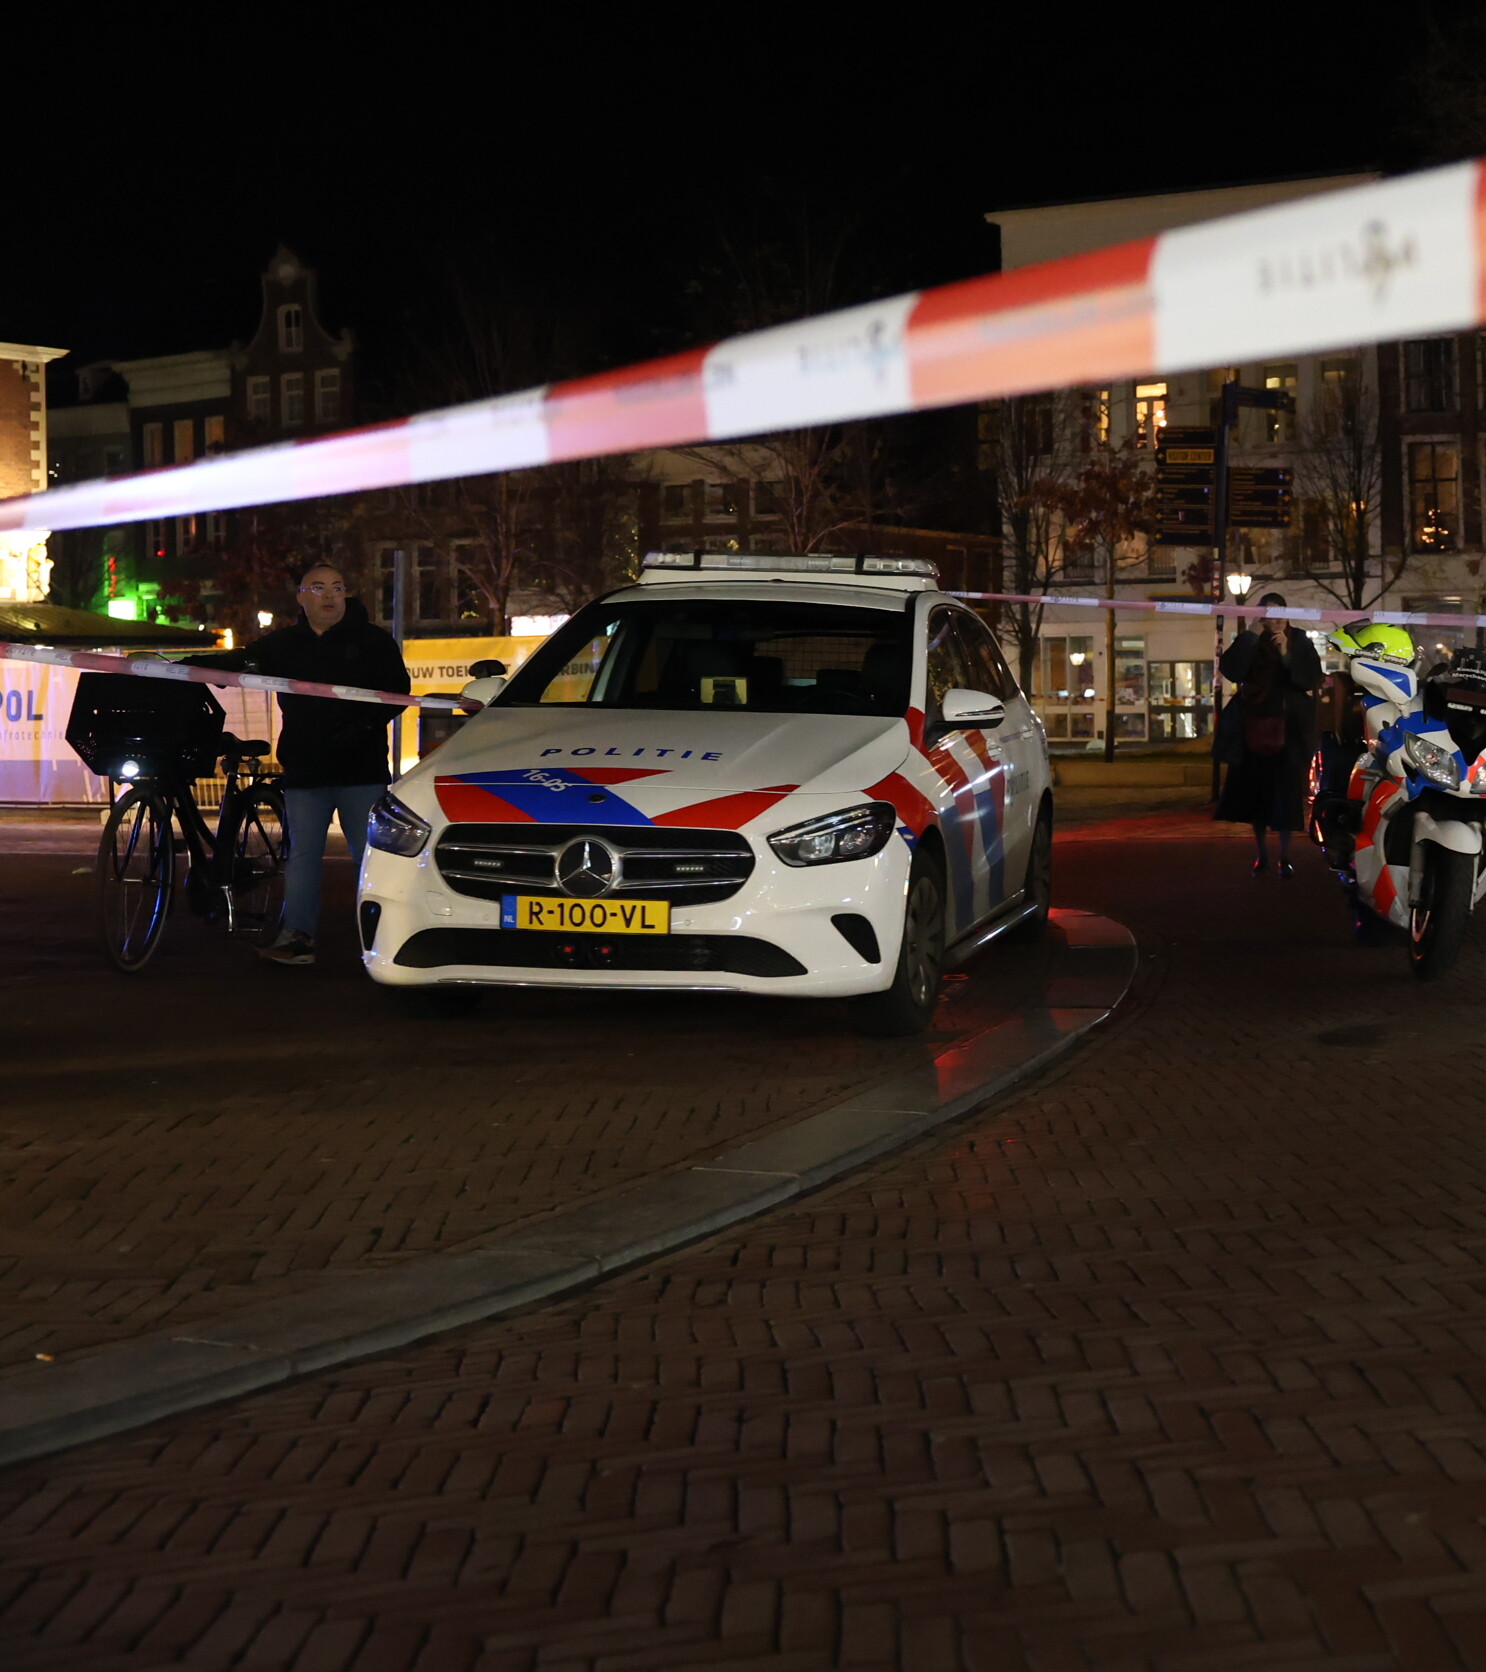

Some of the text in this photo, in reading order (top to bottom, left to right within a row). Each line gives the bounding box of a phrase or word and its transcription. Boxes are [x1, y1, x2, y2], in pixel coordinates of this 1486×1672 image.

[405, 666, 435, 679] UW
[0, 690, 43, 722] OL
[540, 747, 723, 762] POLITIE
[521, 768, 568, 793] 16-05
[503, 900, 656, 930] NL R-100-VL
